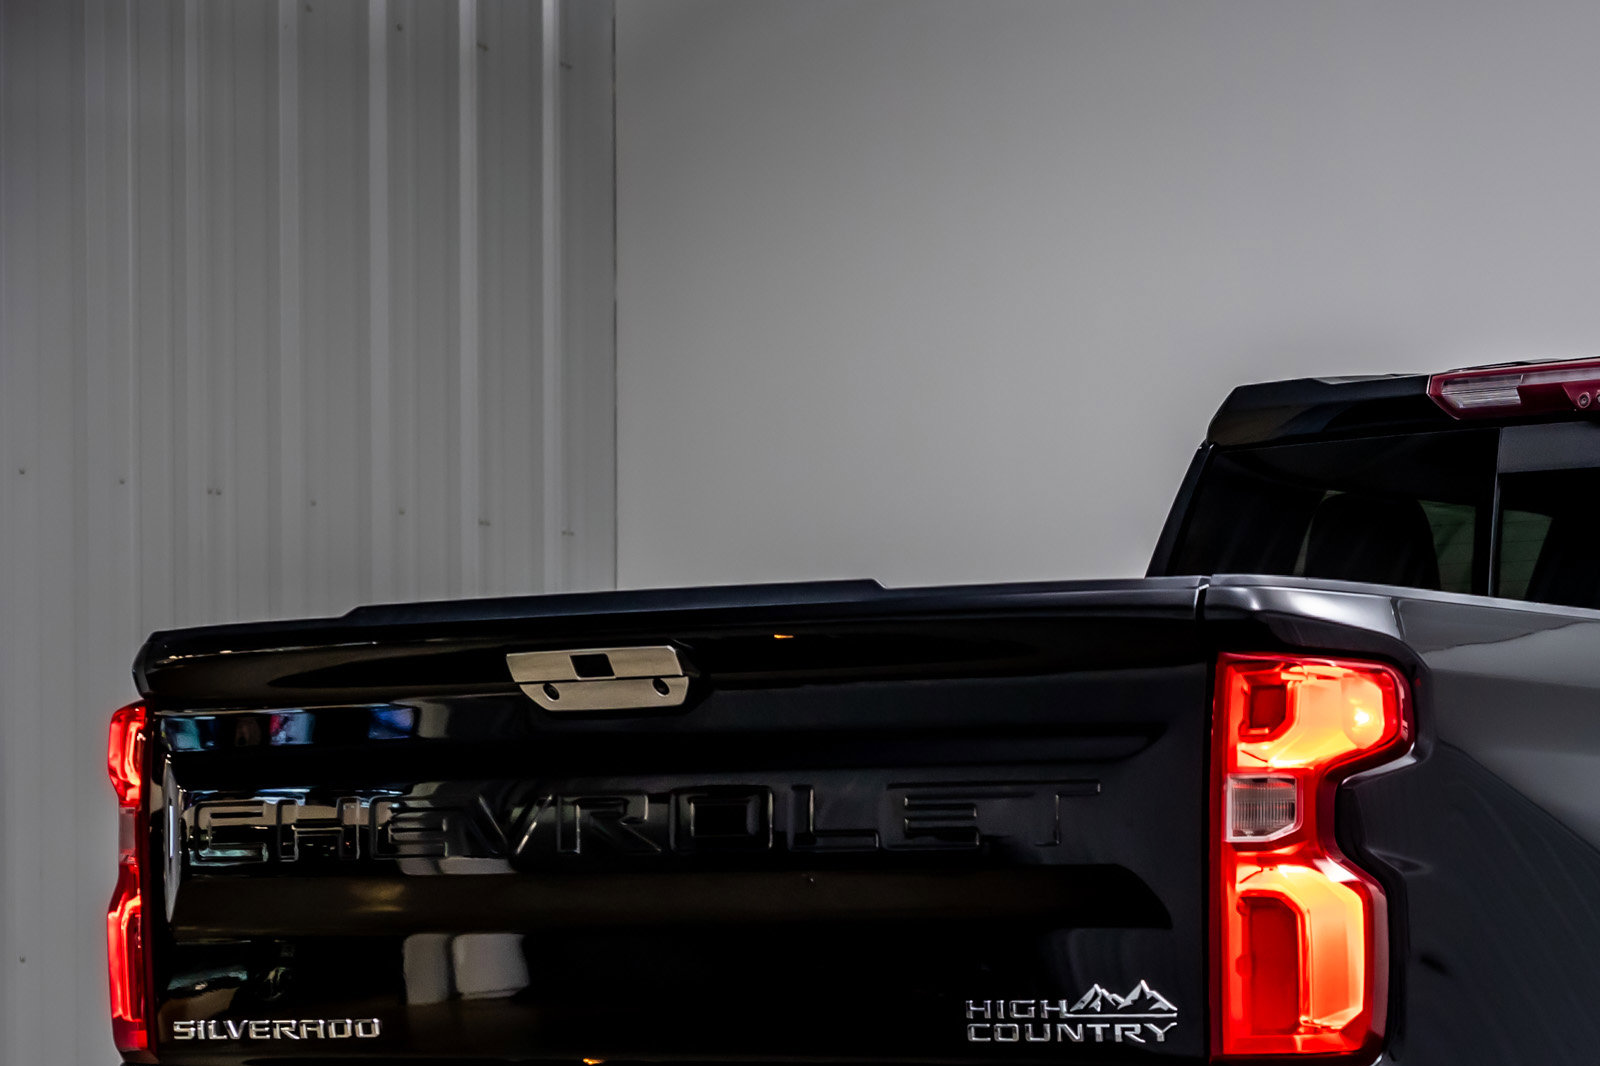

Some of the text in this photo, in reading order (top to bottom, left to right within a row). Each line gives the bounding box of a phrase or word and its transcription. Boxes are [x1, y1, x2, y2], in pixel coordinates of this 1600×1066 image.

[192, 780, 1102, 864] CHEVROLET
[965, 999, 1067, 1019] HIGH
[173, 1018, 382, 1040] SILVERADO
[967, 1022, 1178, 1043] COUNTRY
